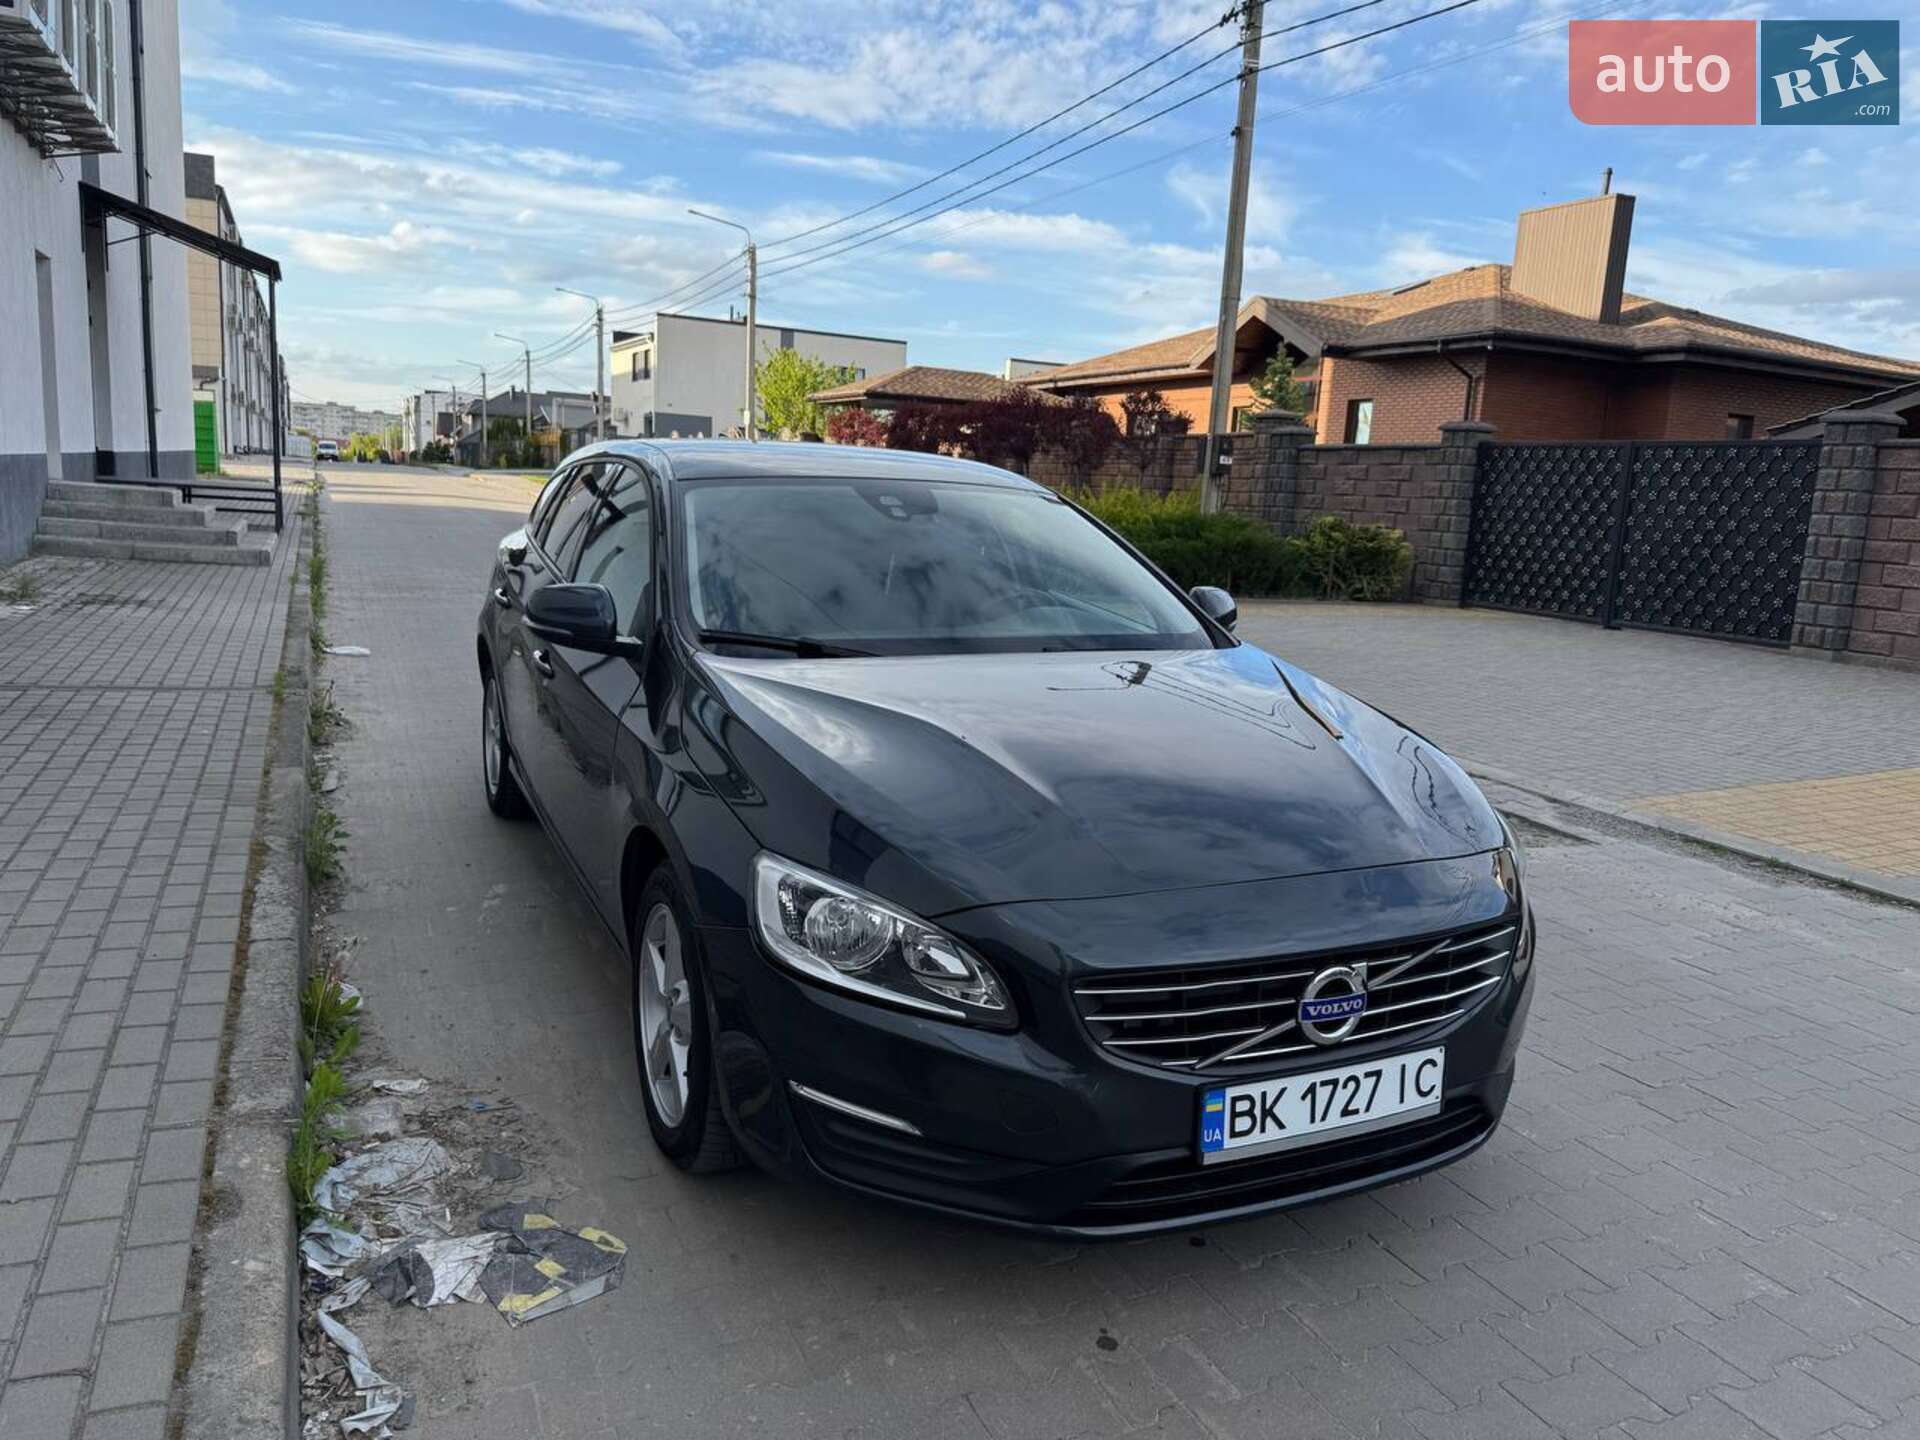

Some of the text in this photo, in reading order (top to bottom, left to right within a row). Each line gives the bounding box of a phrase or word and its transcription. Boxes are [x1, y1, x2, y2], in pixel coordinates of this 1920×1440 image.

[1305, 998, 1363, 1017] VOLVO
[1229, 1058, 1438, 1139] BK 1727 IC
[1203, 1128, 1222, 1142] UA
